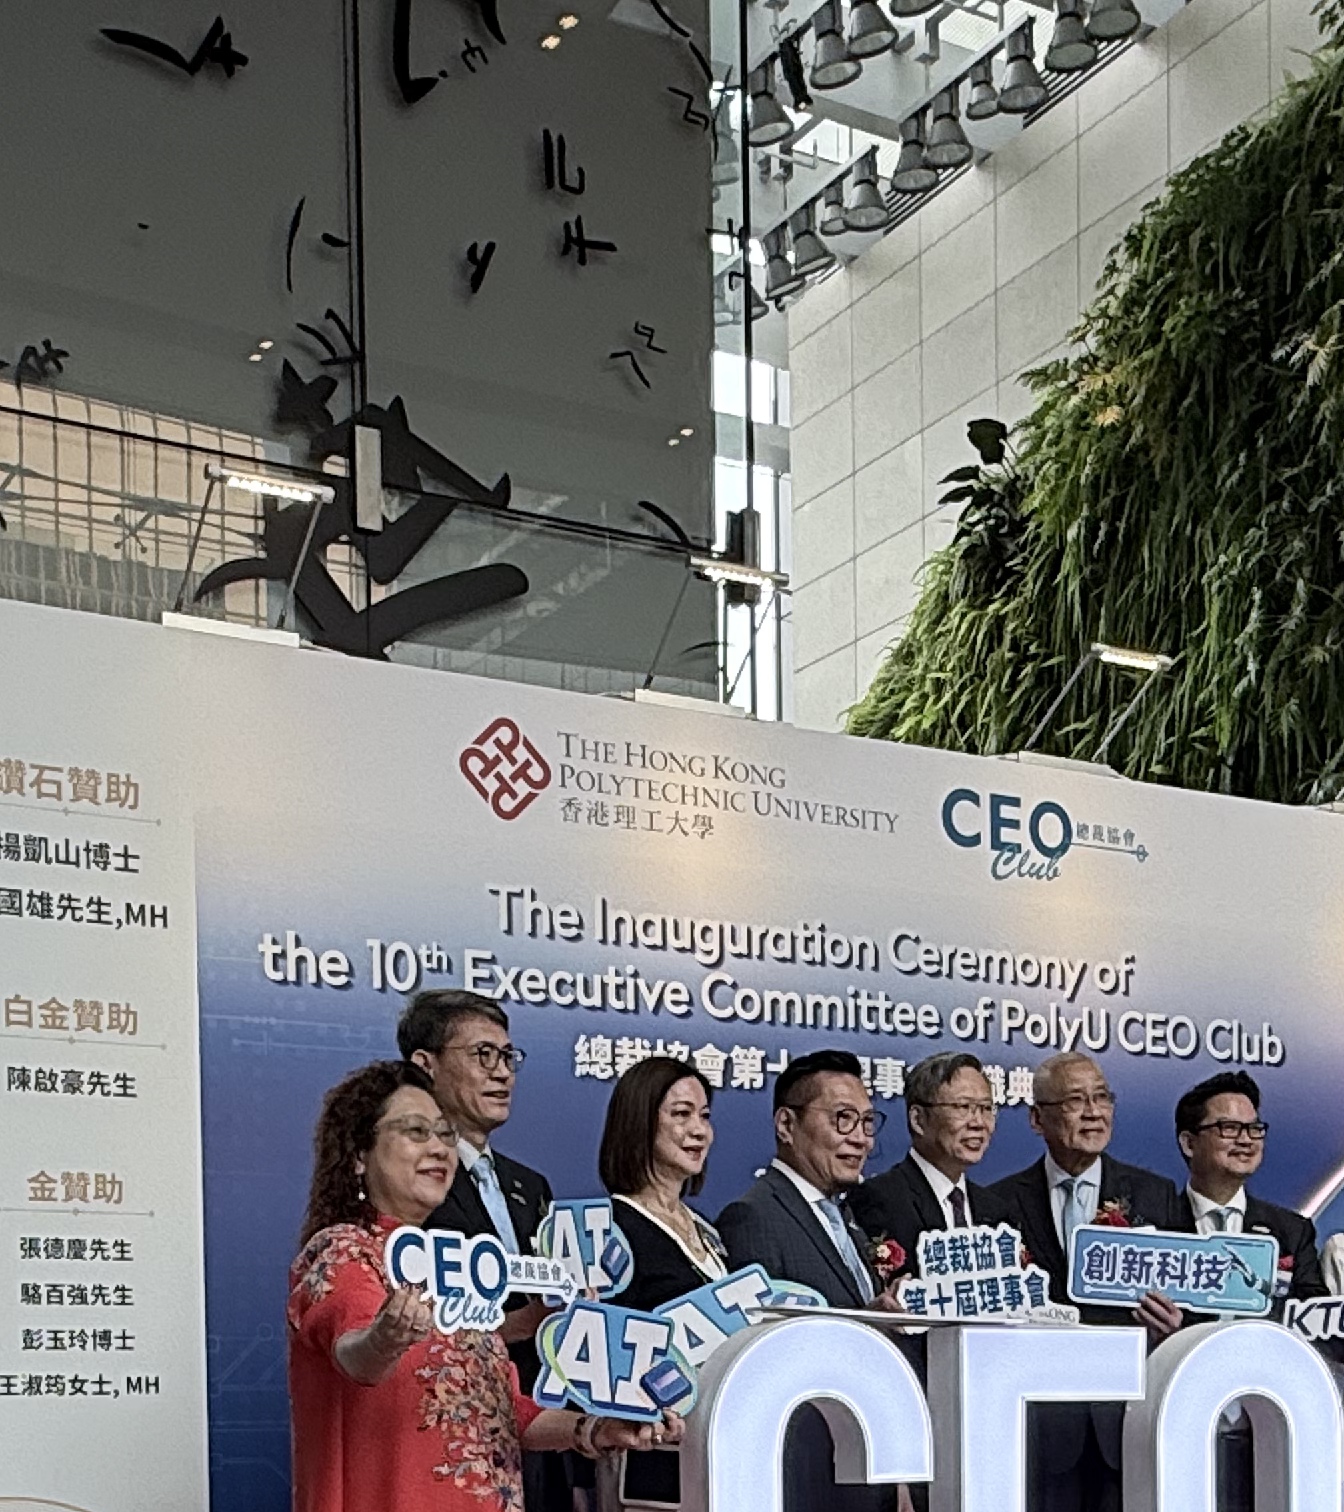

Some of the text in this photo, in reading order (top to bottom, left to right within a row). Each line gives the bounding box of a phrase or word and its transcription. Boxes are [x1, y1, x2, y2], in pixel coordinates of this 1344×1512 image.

[557, 731, 786, 789] THE HONG KONG
[559, 763, 899, 833] POLYTECHNIC UNIVERSITY
[560, 796, 715, 840] 香港理工大學
[942, 788, 1072, 858] CEO
[991, 842, 1061, 881] Club
[487, 884, 1137, 1001] The Inauguration Ceremony of
[5, 994, 138, 1036] 白金贊助
[258, 930, 1288, 1066] the 10th Executive Committee of PolyU CEO Club
[27, 1170, 124, 1205] 金贊助
[19, 1236, 134, 1262] 張德慶先生
[392, 1232, 507, 1301] CEO
[550, 1206, 613, 1292] AI
[923, 1232, 1017, 1277] 總裁協會
[1083, 1243, 1230, 1292] 創新科技
[20, 1282, 135, 1306] 駱百強先生
[440, 1287, 501, 1328] Club
[903, 1270, 1046, 1317] 第十屆理事會
[21, 1328, 136, 1352] 彭玉玲博士
[542, 1307, 671, 1411] AI
[126, 1375, 160, 1395] MH
